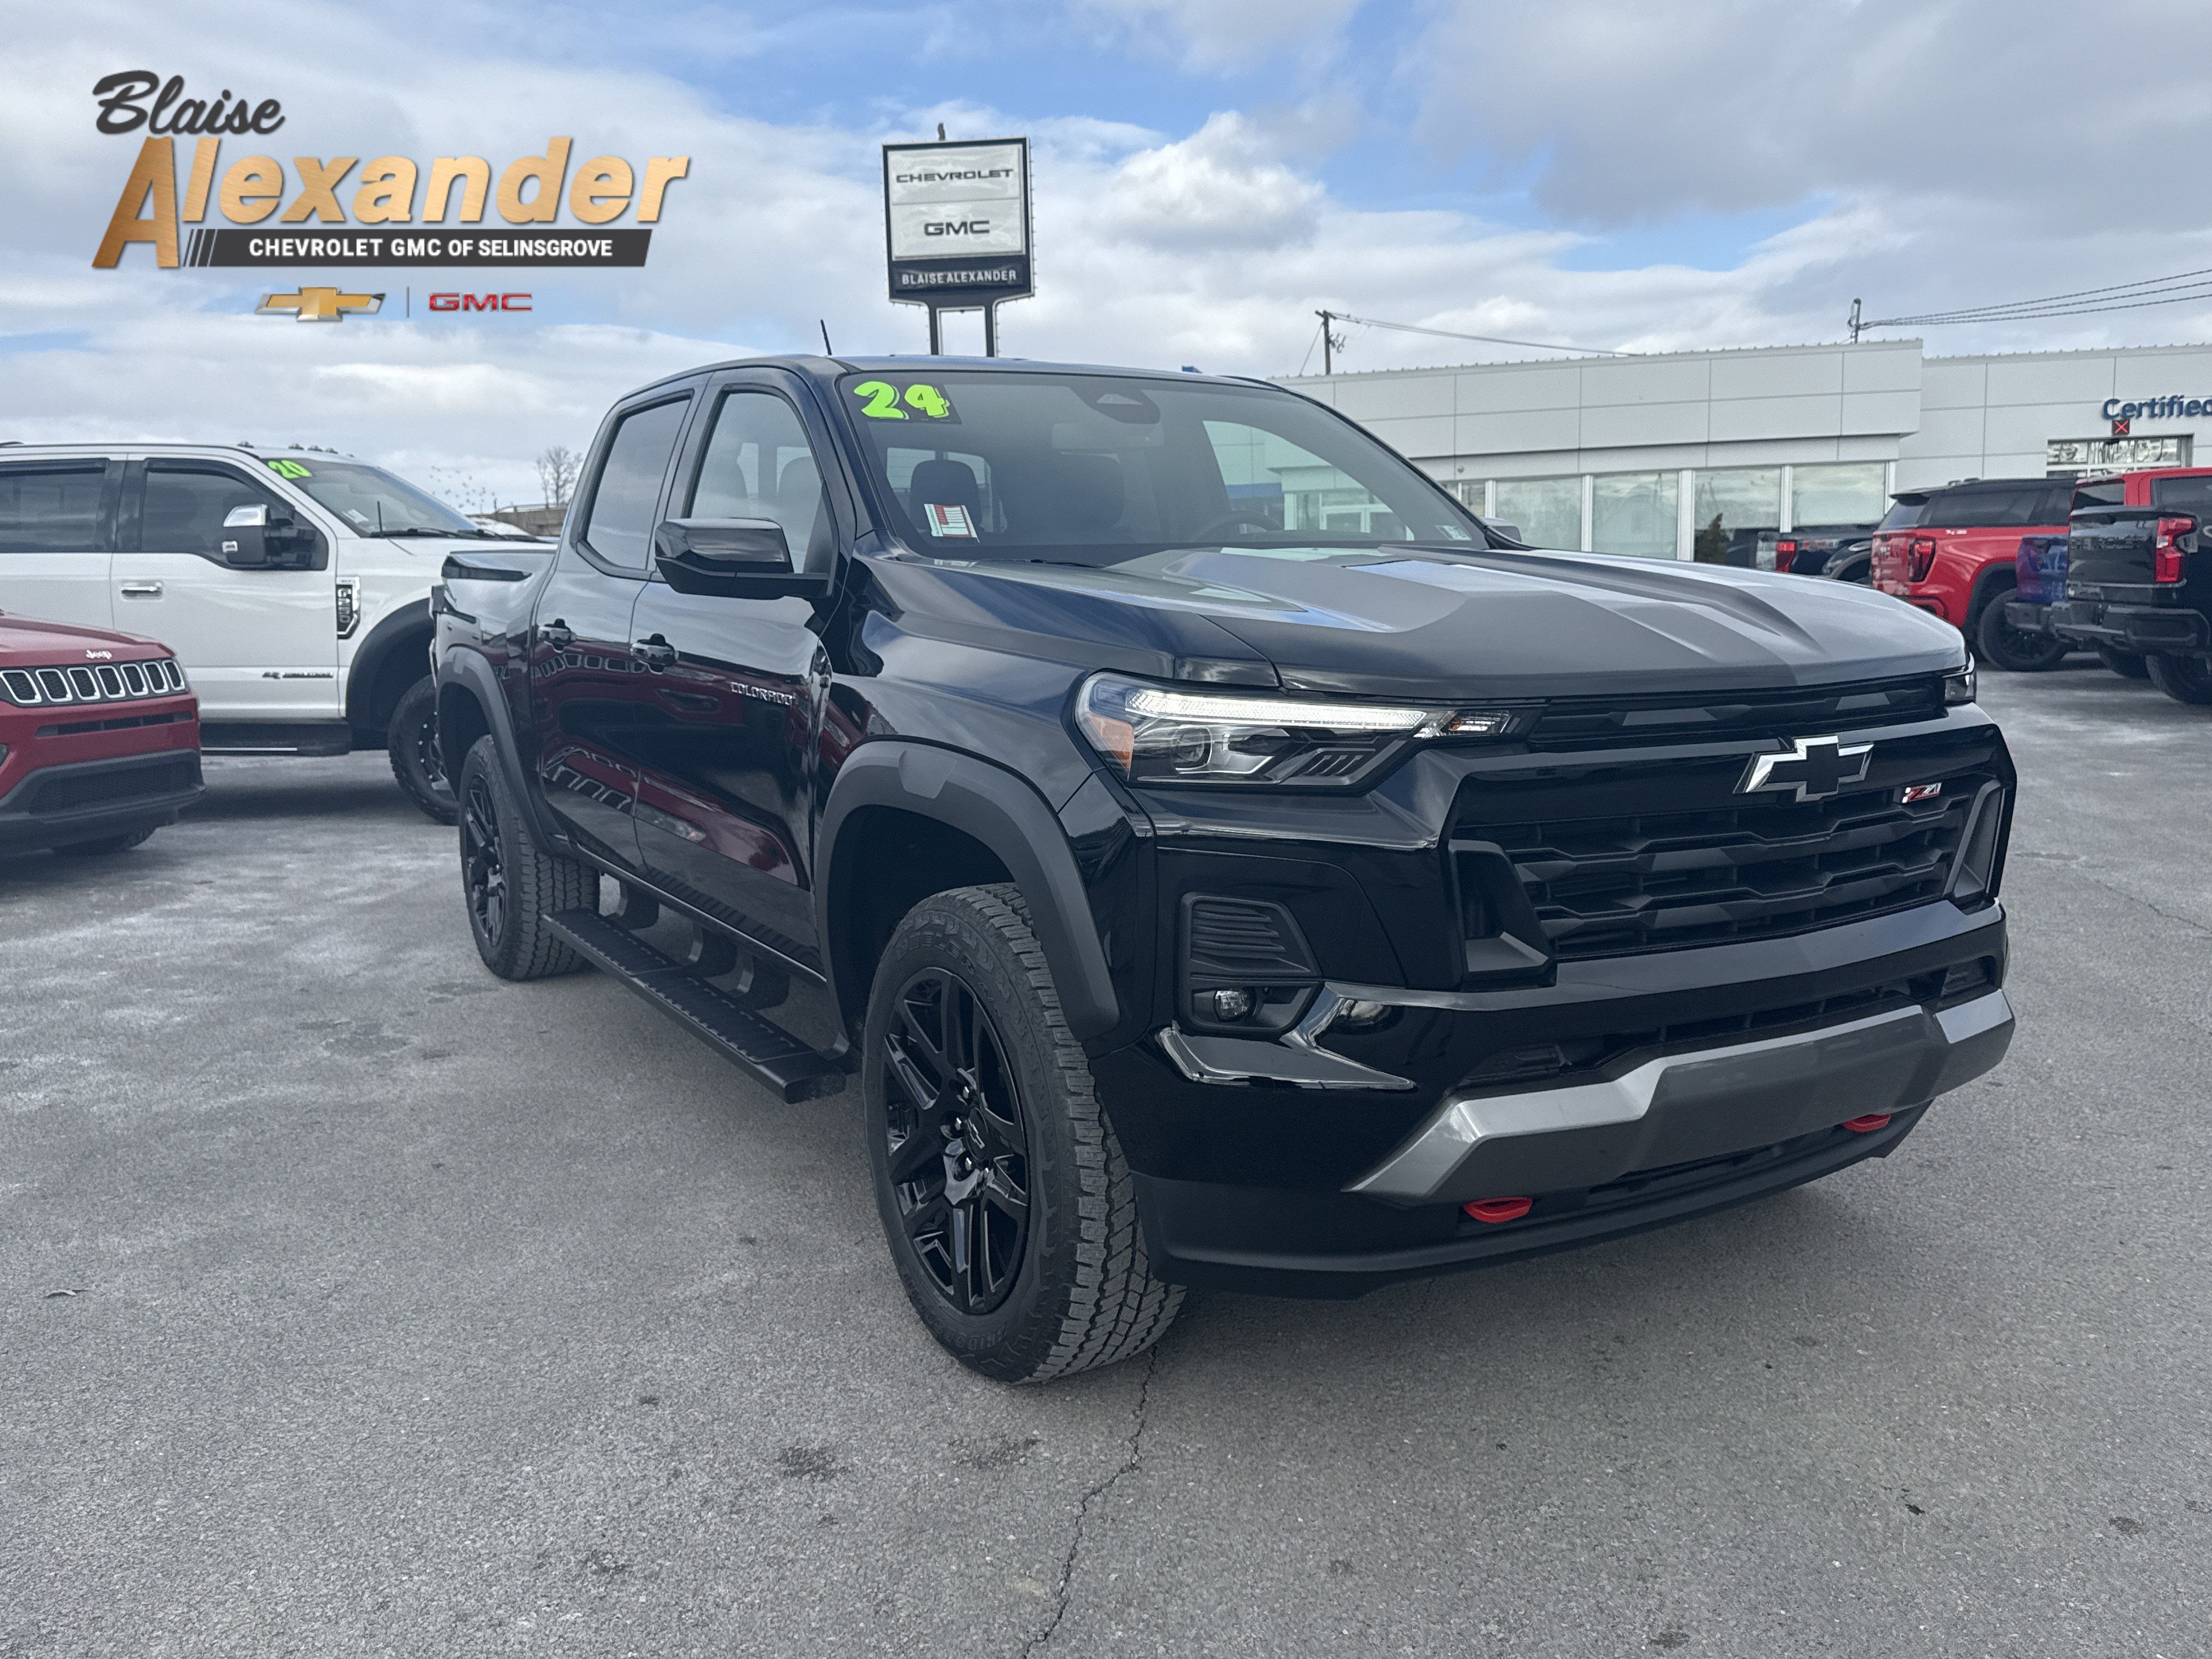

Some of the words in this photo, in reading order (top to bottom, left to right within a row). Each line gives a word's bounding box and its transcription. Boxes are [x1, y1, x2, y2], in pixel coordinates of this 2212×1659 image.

[896, 168, 1014, 183] CHEVROLET
[924, 220, 990, 236] GMC
[901, 273, 944, 285] BLAISE
[947, 270, 1017, 283] ALEXANDER
[854, 381, 950, 420] 24
[731, 681, 793, 706] COLORADO
